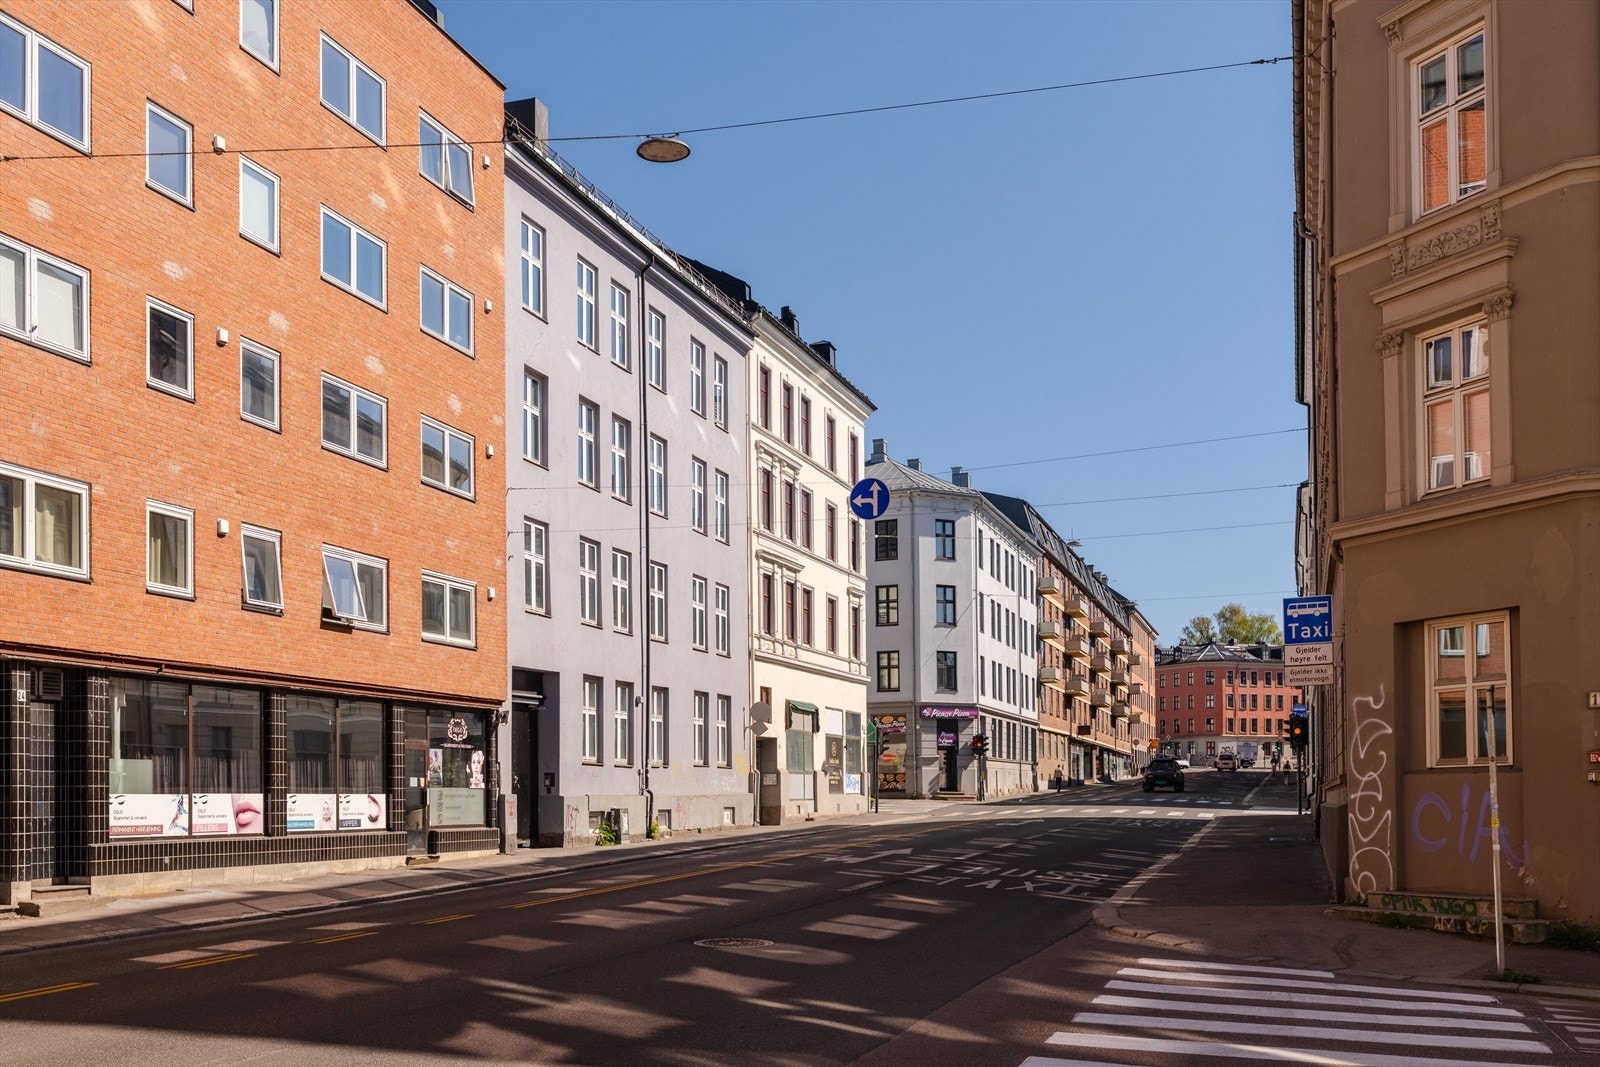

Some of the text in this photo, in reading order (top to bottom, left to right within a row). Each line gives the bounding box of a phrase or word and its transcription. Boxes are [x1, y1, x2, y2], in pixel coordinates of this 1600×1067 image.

[1288, 621, 1329, 639] Taxi
[1295, 647, 1321, 656] Gjelder
[1290, 656, 1311, 664] høyre
[1289, 675, 1330, 684] elmotorvogn
[18, 691, 25, 700] 24
[342, 819, 358, 827] VIPPER
[935, 876, 1083, 895] TAXI
